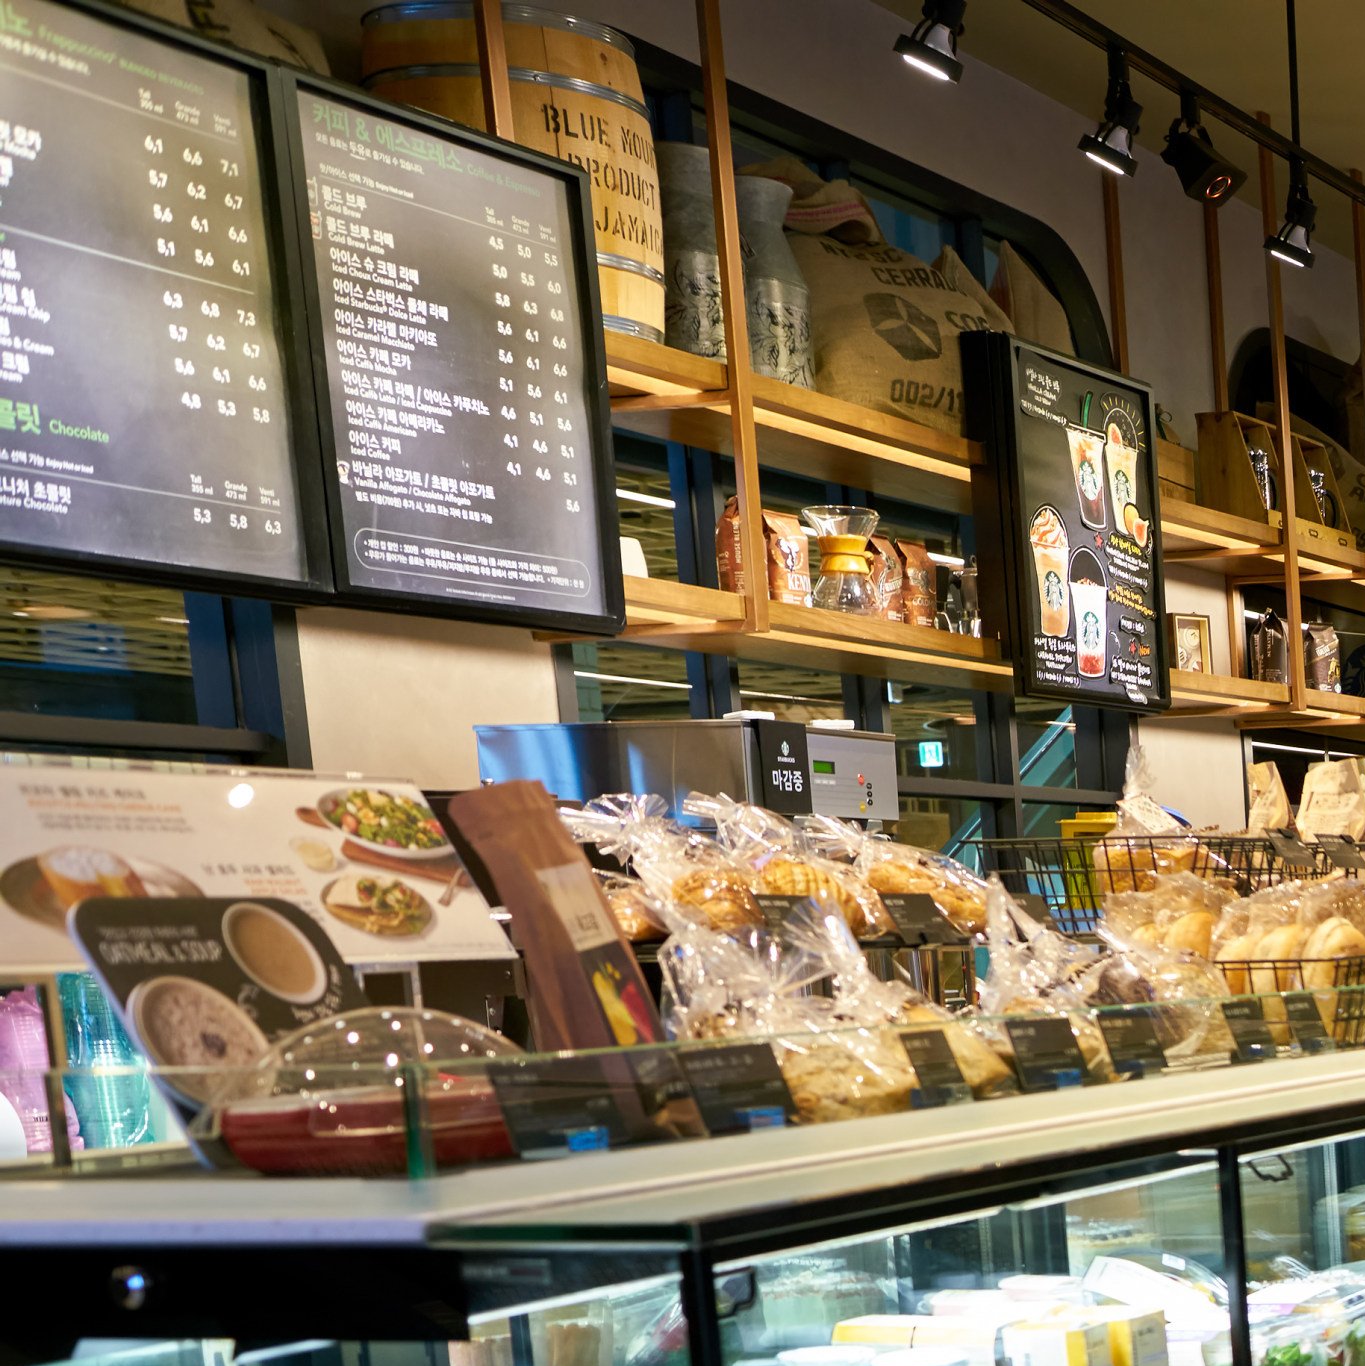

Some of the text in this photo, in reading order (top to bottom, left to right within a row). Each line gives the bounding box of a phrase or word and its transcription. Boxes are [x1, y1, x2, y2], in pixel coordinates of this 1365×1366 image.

[313, 103, 349, 137] 커피
[356, 123, 370, 142] &
[375, 126, 462, 172] 에스프레소
[542, 104, 611, 148] BLUE
[144, 135, 239, 176] 6,1 6,6 7,1
[322, 185, 367, 210] 콜드 브루
[153, 204, 247, 244] 5,6 6,1 6,6
[157, 238, 250, 276] 5,1 5,6 6,1
[330, 247, 419, 285] 아이스 슈 크림 라떼
[489, 236, 558, 267] 4,5 5,0 5,5
[492, 264, 562, 294] 5,0 5,5 6,0
[163, 291, 256, 326] 6,3 6,8 7,3
[333, 278, 449, 321] 아이스 스타벅스 돌체 라떼
[495, 292, 564, 322] 5,8 6,3 6,8
[169, 324, 260, 359] 5,7 6,2 6,7
[334, 309, 438, 347] 아이스 카라멜 마키아또
[498, 321, 567, 349] 5,6 6,1 6,6
[337, 339, 411, 370] 아이스 카페 모카
[499, 349, 567, 377] 5,6 6,1 6,6
[174, 357, 267, 391] 5,6 6,1 6,6
[181, 392, 270, 423] 4,8 5,3 5,8
[341, 369, 490, 416] 아이스 카페 라떼 아이스 카푸치노
[49, 419, 110, 443] Chocolate
[345, 399, 445, 434] 아이스 카페 아메리카노
[501, 406, 572, 432] 4,6 5,1 5,6
[349, 430, 401, 454] 아이스 커피
[504, 434, 574, 458] 4,1 4,6 5,1
[352, 461, 495, 500] 바닐라 아포가토 초콜릿 아포가토
[507, 461, 577, 485] 4,1 4,6 5,1
[24, 498, 68, 514] Chocolate
[194, 508, 281, 535] 5,3 5,8 6,3
[566, 499, 580, 513] 5,6
[772, 769, 803, 792] 마감중
